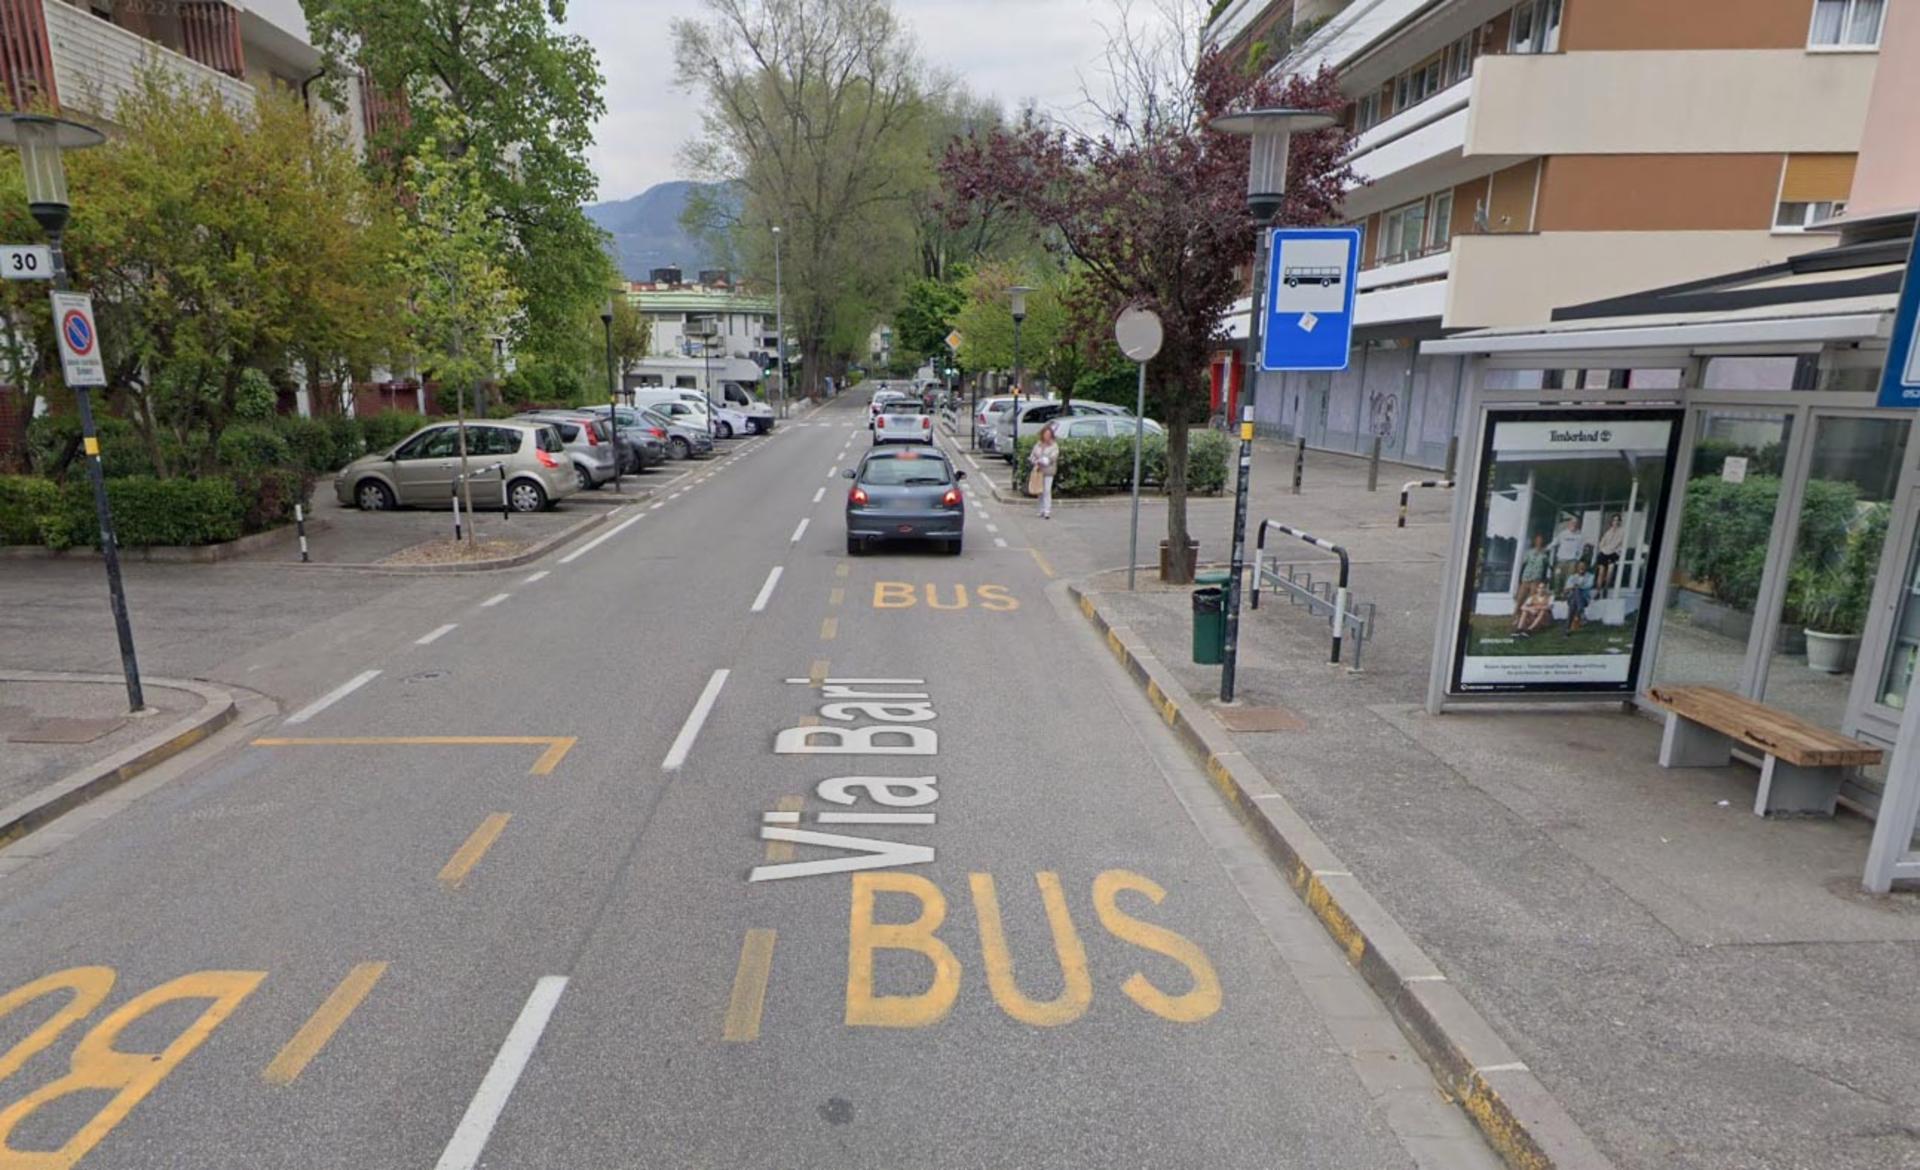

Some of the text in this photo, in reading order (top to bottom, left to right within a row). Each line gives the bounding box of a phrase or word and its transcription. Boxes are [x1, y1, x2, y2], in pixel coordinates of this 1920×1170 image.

[12, 253, 37, 270] 30
[1549, 429, 1599, 442] Timberland
[872, 581, 1020, 611] BUS
[845, 868, 1222, 1028] BUS
